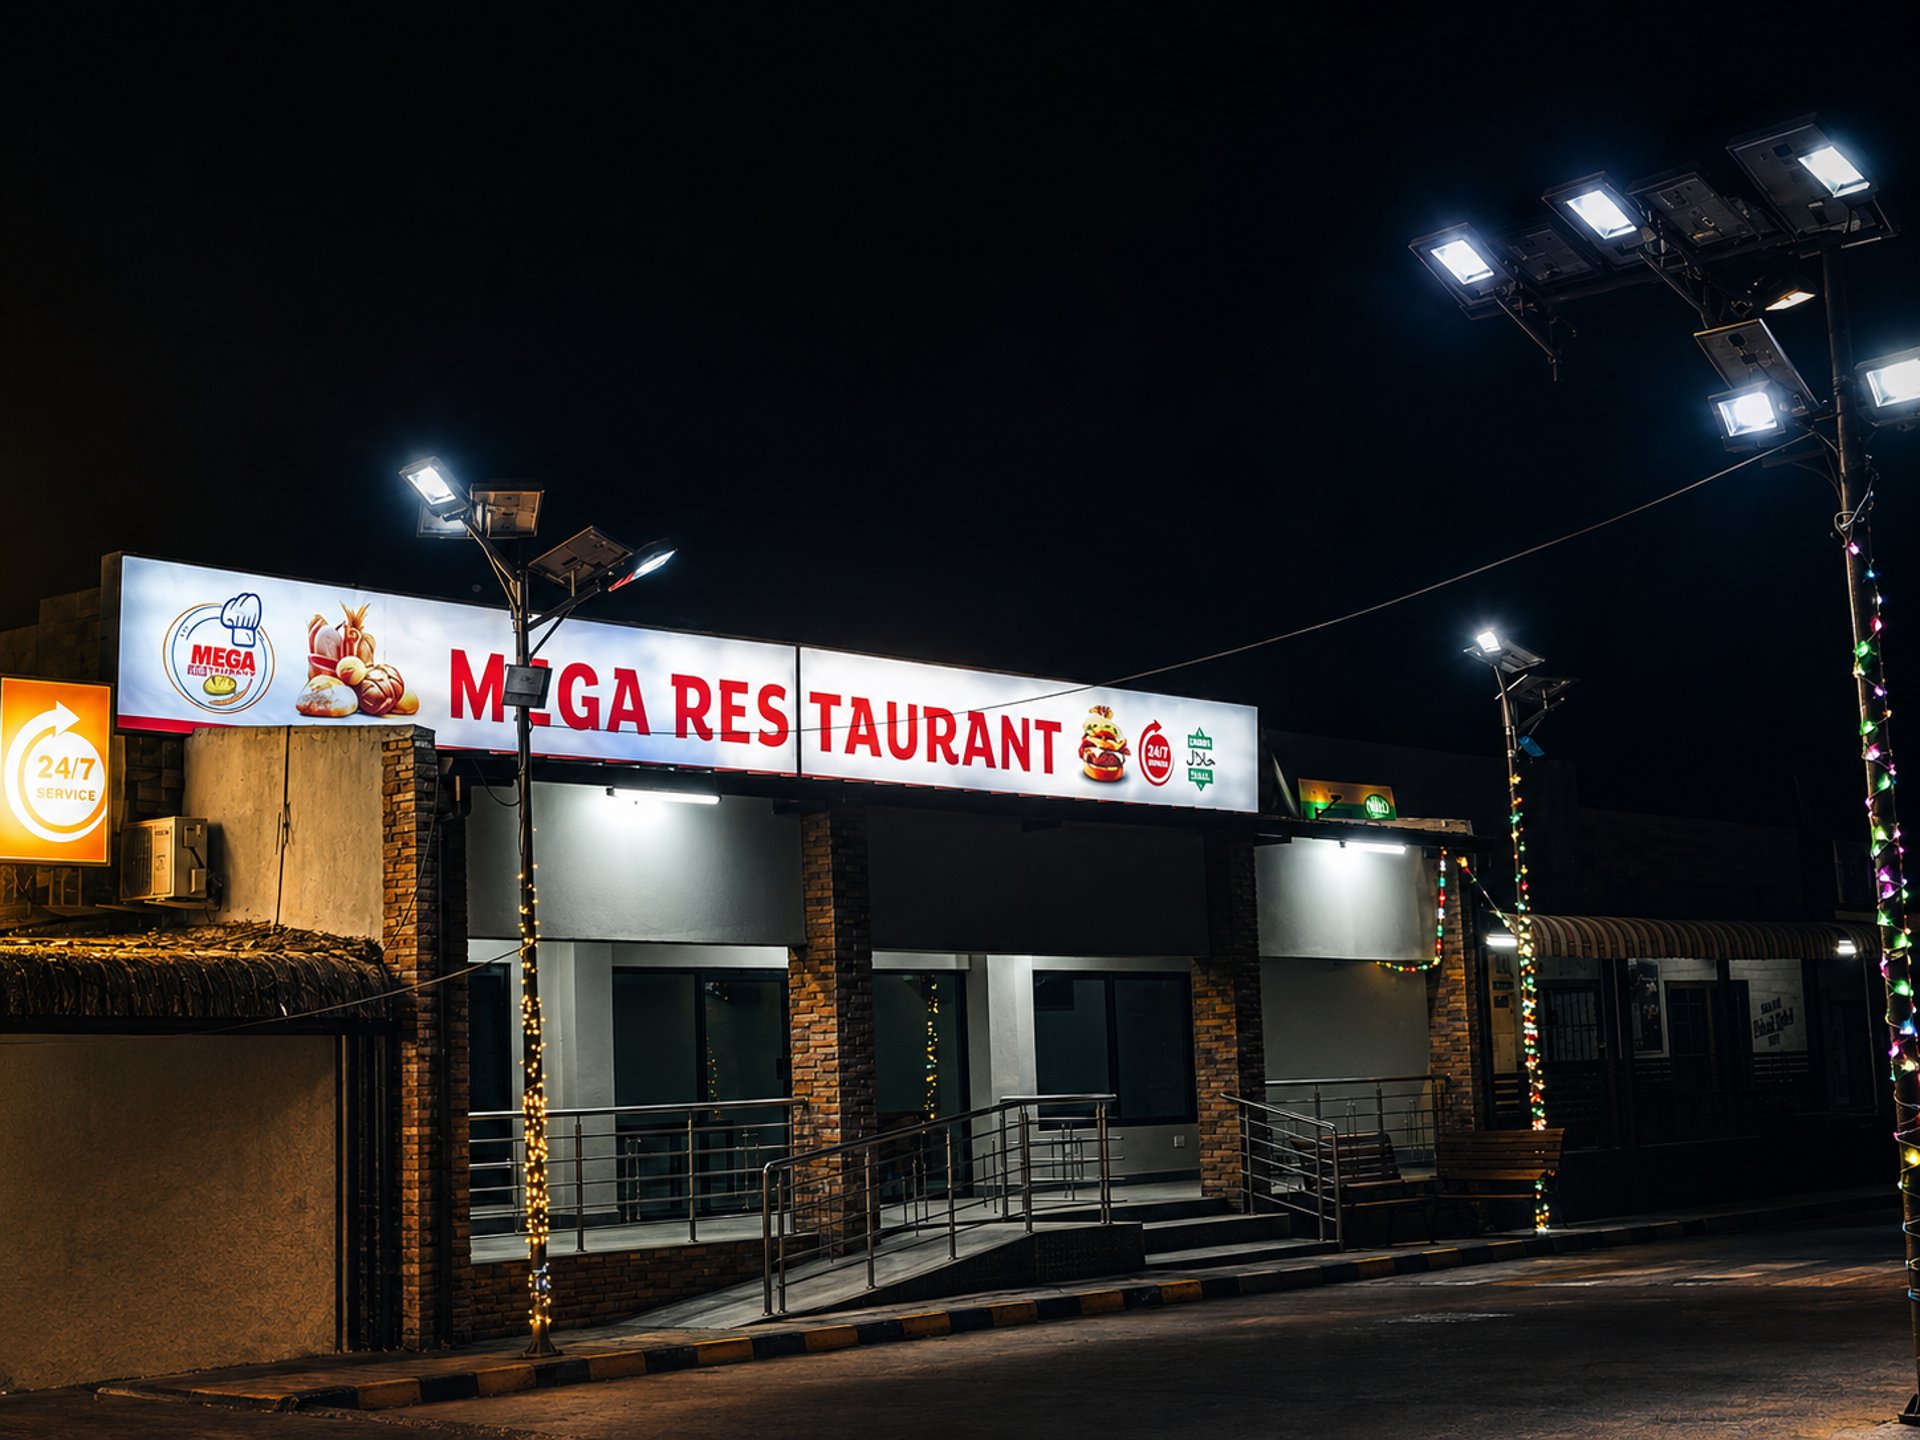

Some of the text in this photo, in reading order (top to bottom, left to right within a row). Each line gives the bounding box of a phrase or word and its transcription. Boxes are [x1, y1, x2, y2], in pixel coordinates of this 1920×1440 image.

[191, 644, 256, 672] MEGA
[37, 755, 96, 781] 24/7
[36, 787, 96, 801] SERVICE
